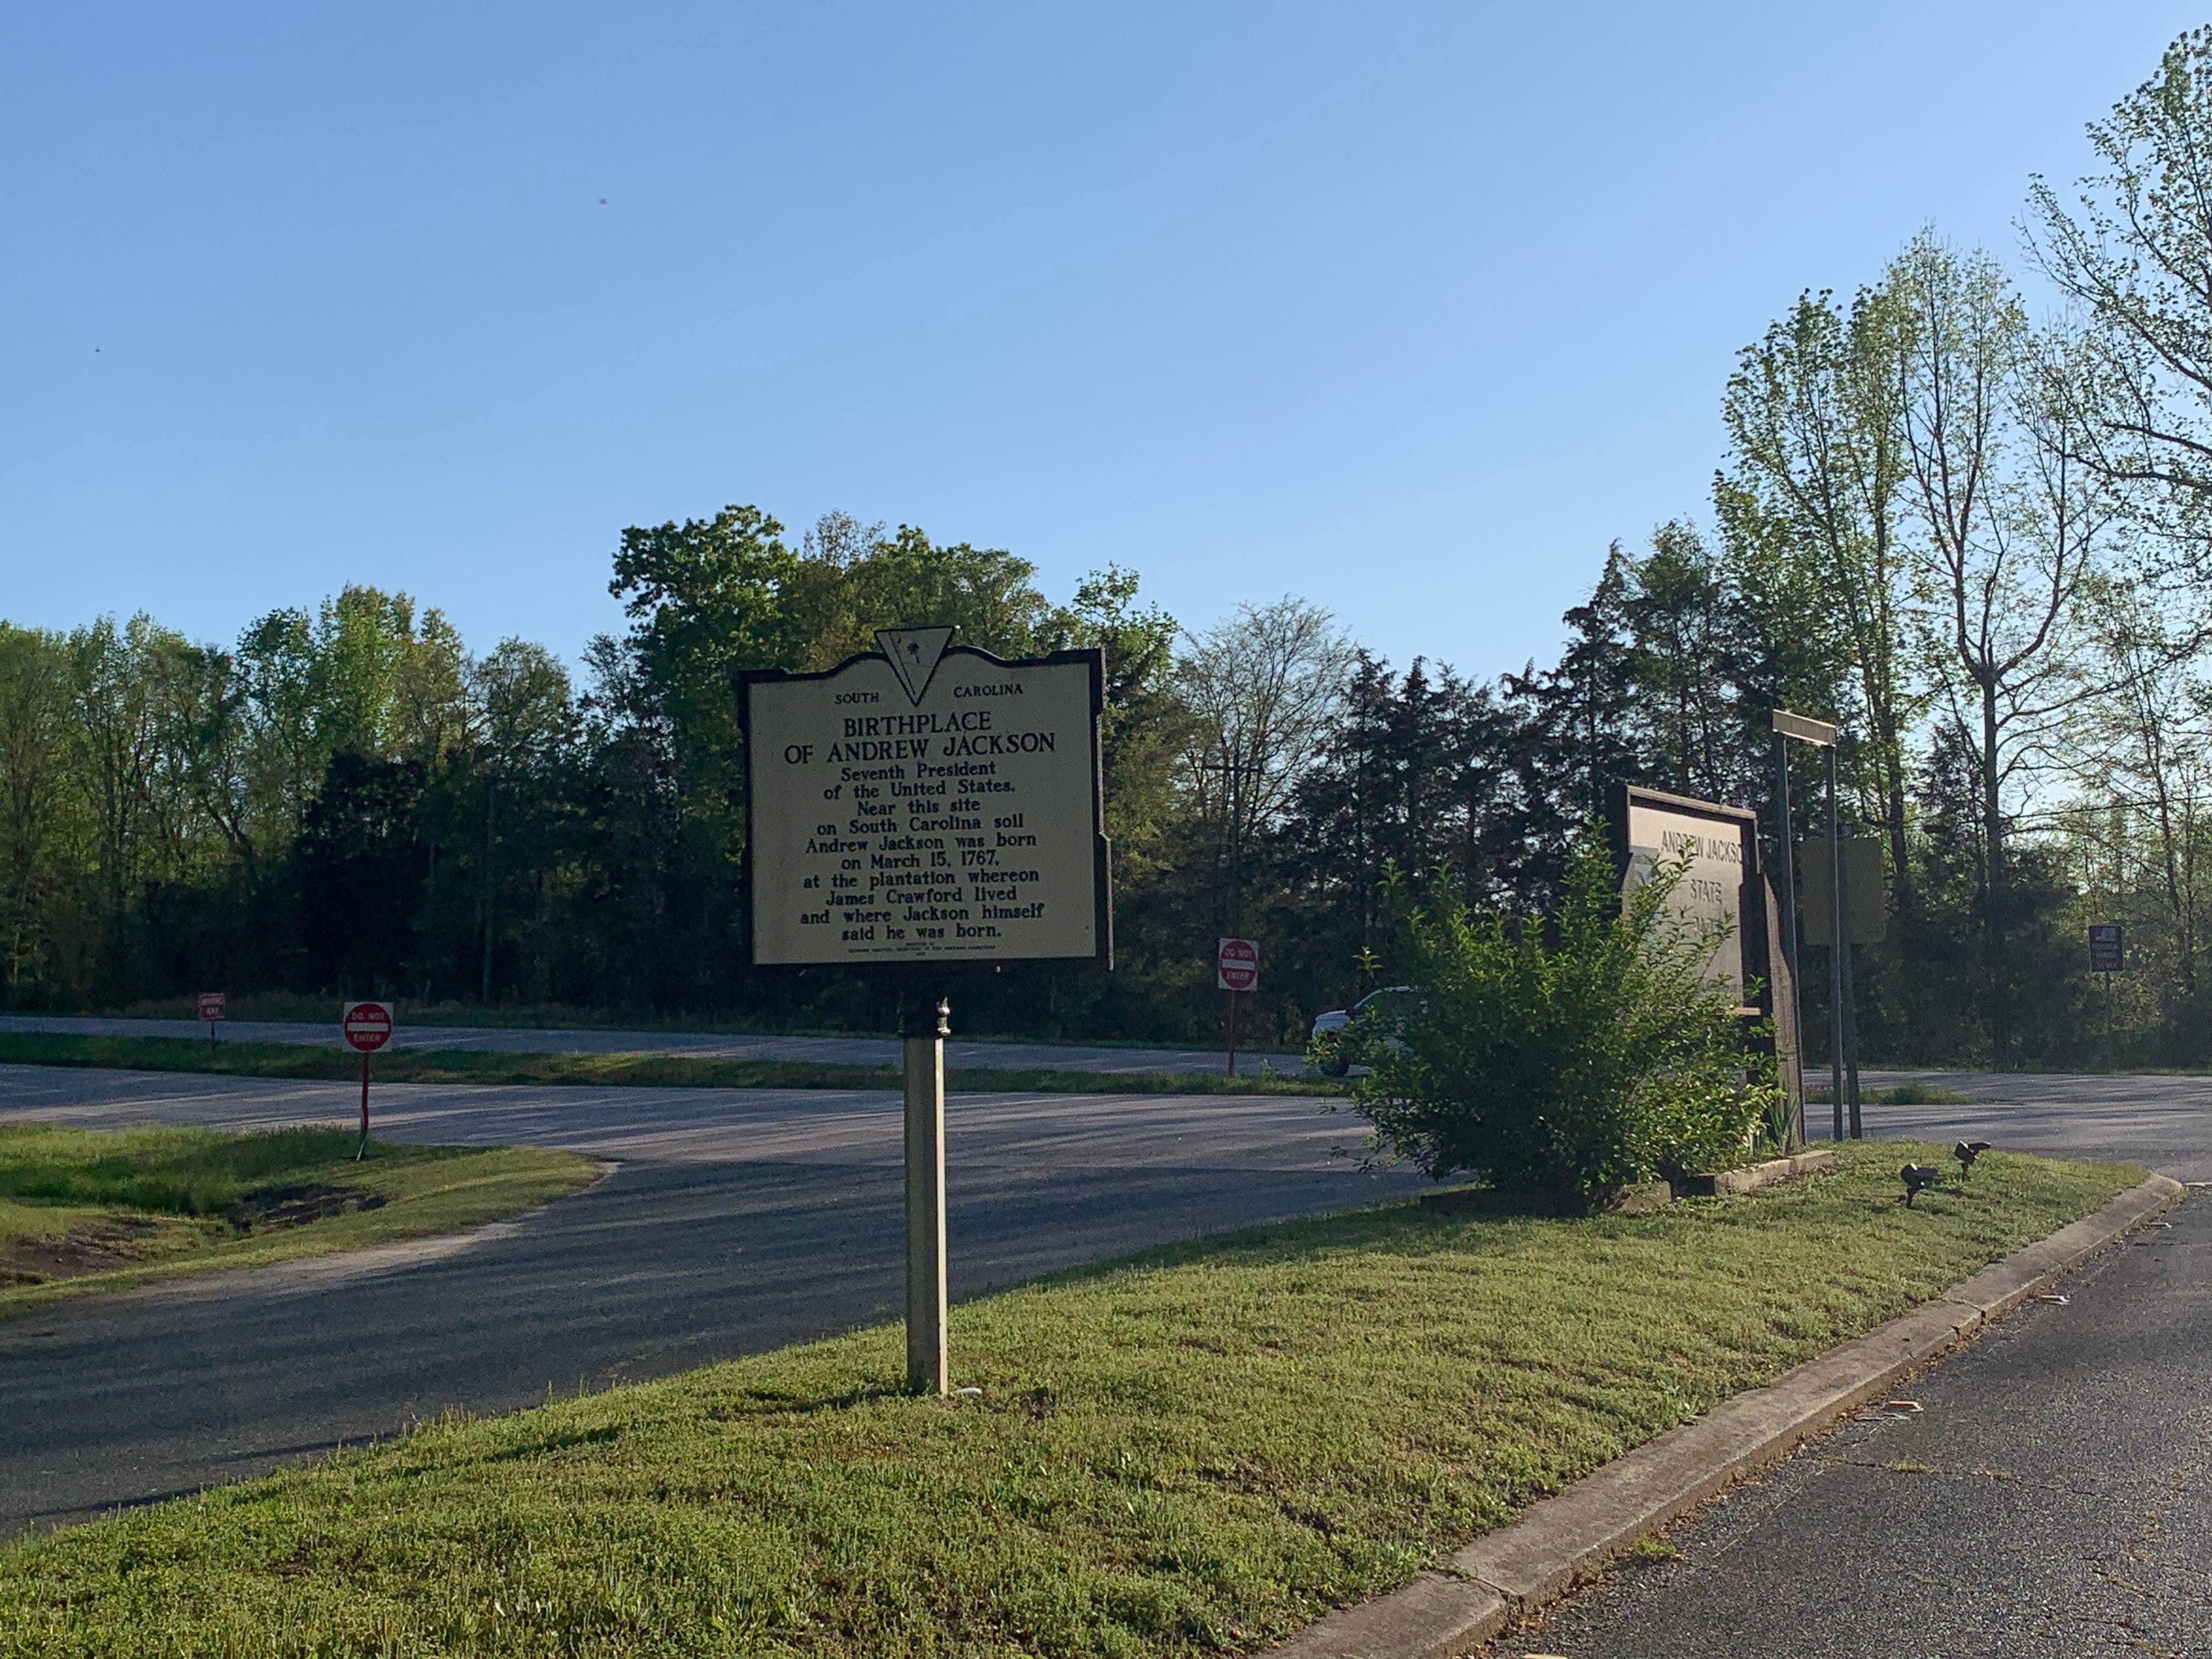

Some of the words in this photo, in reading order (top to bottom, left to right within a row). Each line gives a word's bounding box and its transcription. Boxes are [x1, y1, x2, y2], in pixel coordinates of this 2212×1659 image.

[834, 692, 879, 704] SOUTH
[953, 683, 1023, 698] CAROLINA
[843, 710, 992, 738] BIRTHPLACE
[784, 744, 813, 764] OF
[826, 738, 930, 763] ANDREW
[943, 732, 1056, 757] JACKSON
[840, 764, 905, 784] Seventh
[917, 761, 996, 780] President
[823, 785, 842, 800] of
[853, 784, 879, 799] the
[890, 780, 946, 797] United
[857, 800, 896, 816] Near
[907, 799, 940, 814] this
[950, 798, 980, 812] site
[817, 824, 837, 836] on
[849, 818, 898, 834] South
[909, 815, 981, 832] Carolina
[994, 813, 1024, 828] soil
[805, 838, 868, 854] Andrew
[879, 835, 945, 852] Jackson
[955, 837, 985, 848] was
[996, 832, 1036, 847] born
[1706, 838, 1748, 864] JACKSO
[841, 859, 861, 871] on
[871, 853, 921, 869] March
[930, 850, 951, 868] 15,
[804, 874, 820, 889] at
[831, 873, 857, 888] the
[869, 871, 956, 891] plantation
[967, 868, 1039, 883] whereon
[826, 890, 874, 906] James
[885, 885, 963, 904] Crawford
[974, 885, 1017, 902] lived
[1690, 879, 1722, 904] STATE
[800, 909, 830, 924] and
[843, 905, 892, 923] where
[903, 905, 969, 921] Jackson
[981, 902, 1045, 919] himself
[842, 926, 874, 941] said
[886, 924, 905, 939] he
[916, 928, 944, 939] was
[956, 923, 1002, 938] born.
[1224, 947, 1236, 957] DO
[1238, 949, 1252, 958] NOT
[1226, 970, 1250, 980] ENTER
[368, 1012, 385, 1020] NOT
[353, 1034, 382, 1042] ENTER
